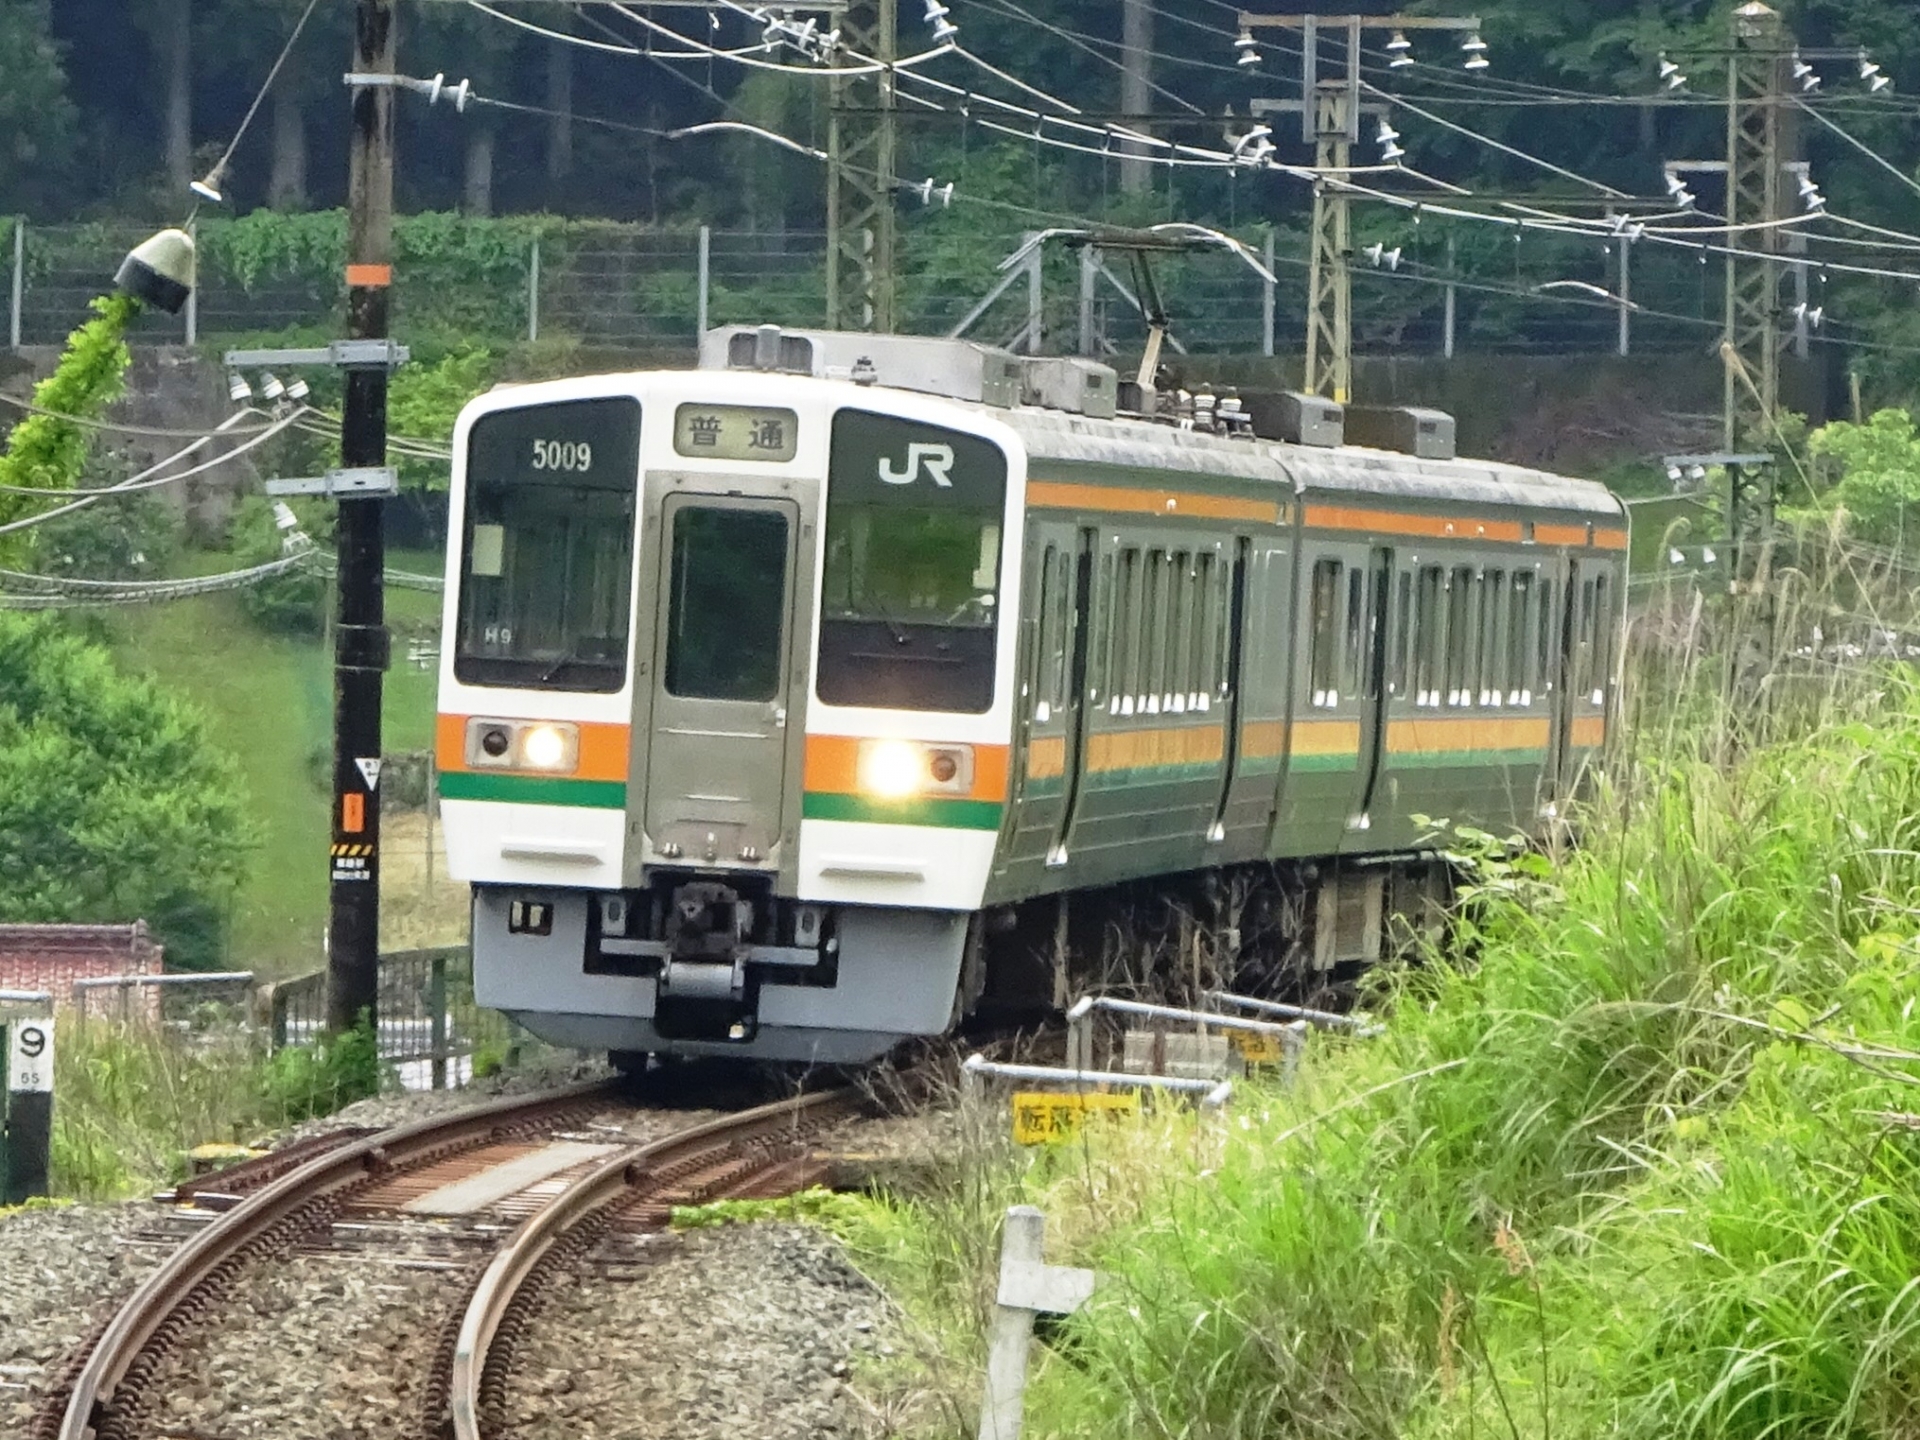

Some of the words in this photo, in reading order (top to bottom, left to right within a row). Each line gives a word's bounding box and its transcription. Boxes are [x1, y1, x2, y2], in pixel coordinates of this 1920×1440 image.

[688, 415, 784, 450] 普通
[533, 439, 591, 472] 5009
[879, 443, 954, 487] JR
[485, 627, 512, 644] H9
[20, 1026, 46, 1058] 9
